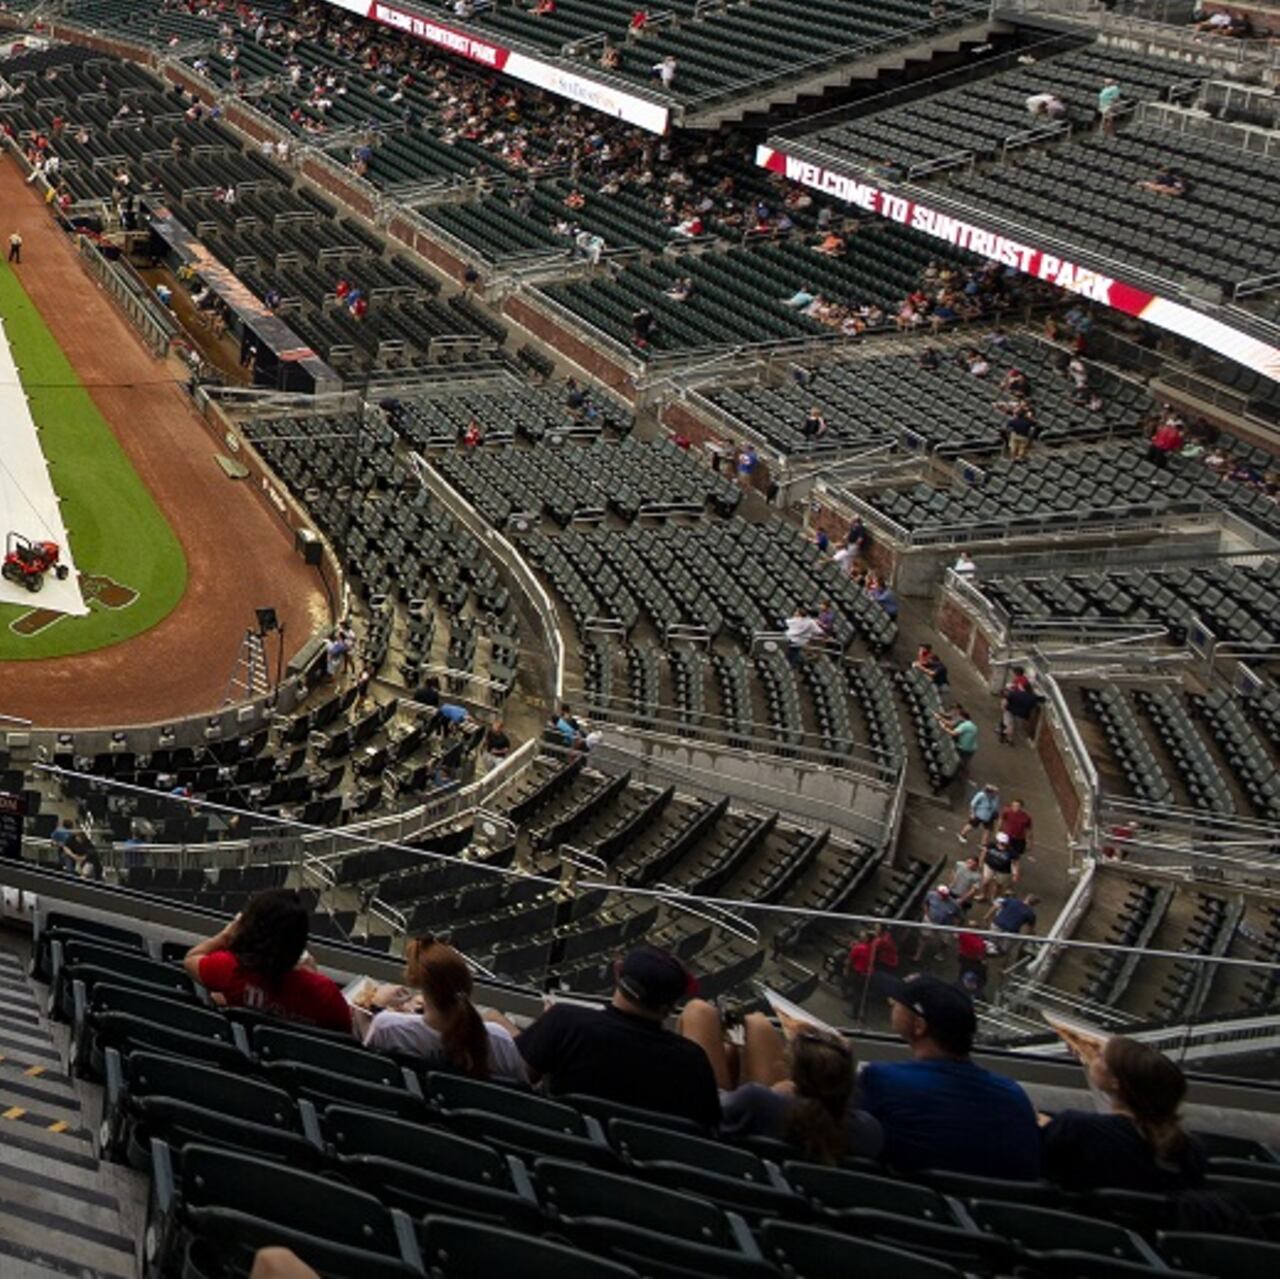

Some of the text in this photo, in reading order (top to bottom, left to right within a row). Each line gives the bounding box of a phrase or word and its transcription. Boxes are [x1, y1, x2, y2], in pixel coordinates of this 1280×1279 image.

[784, 156, 1115, 304] WELCOME TO SUNTRUST PARK
